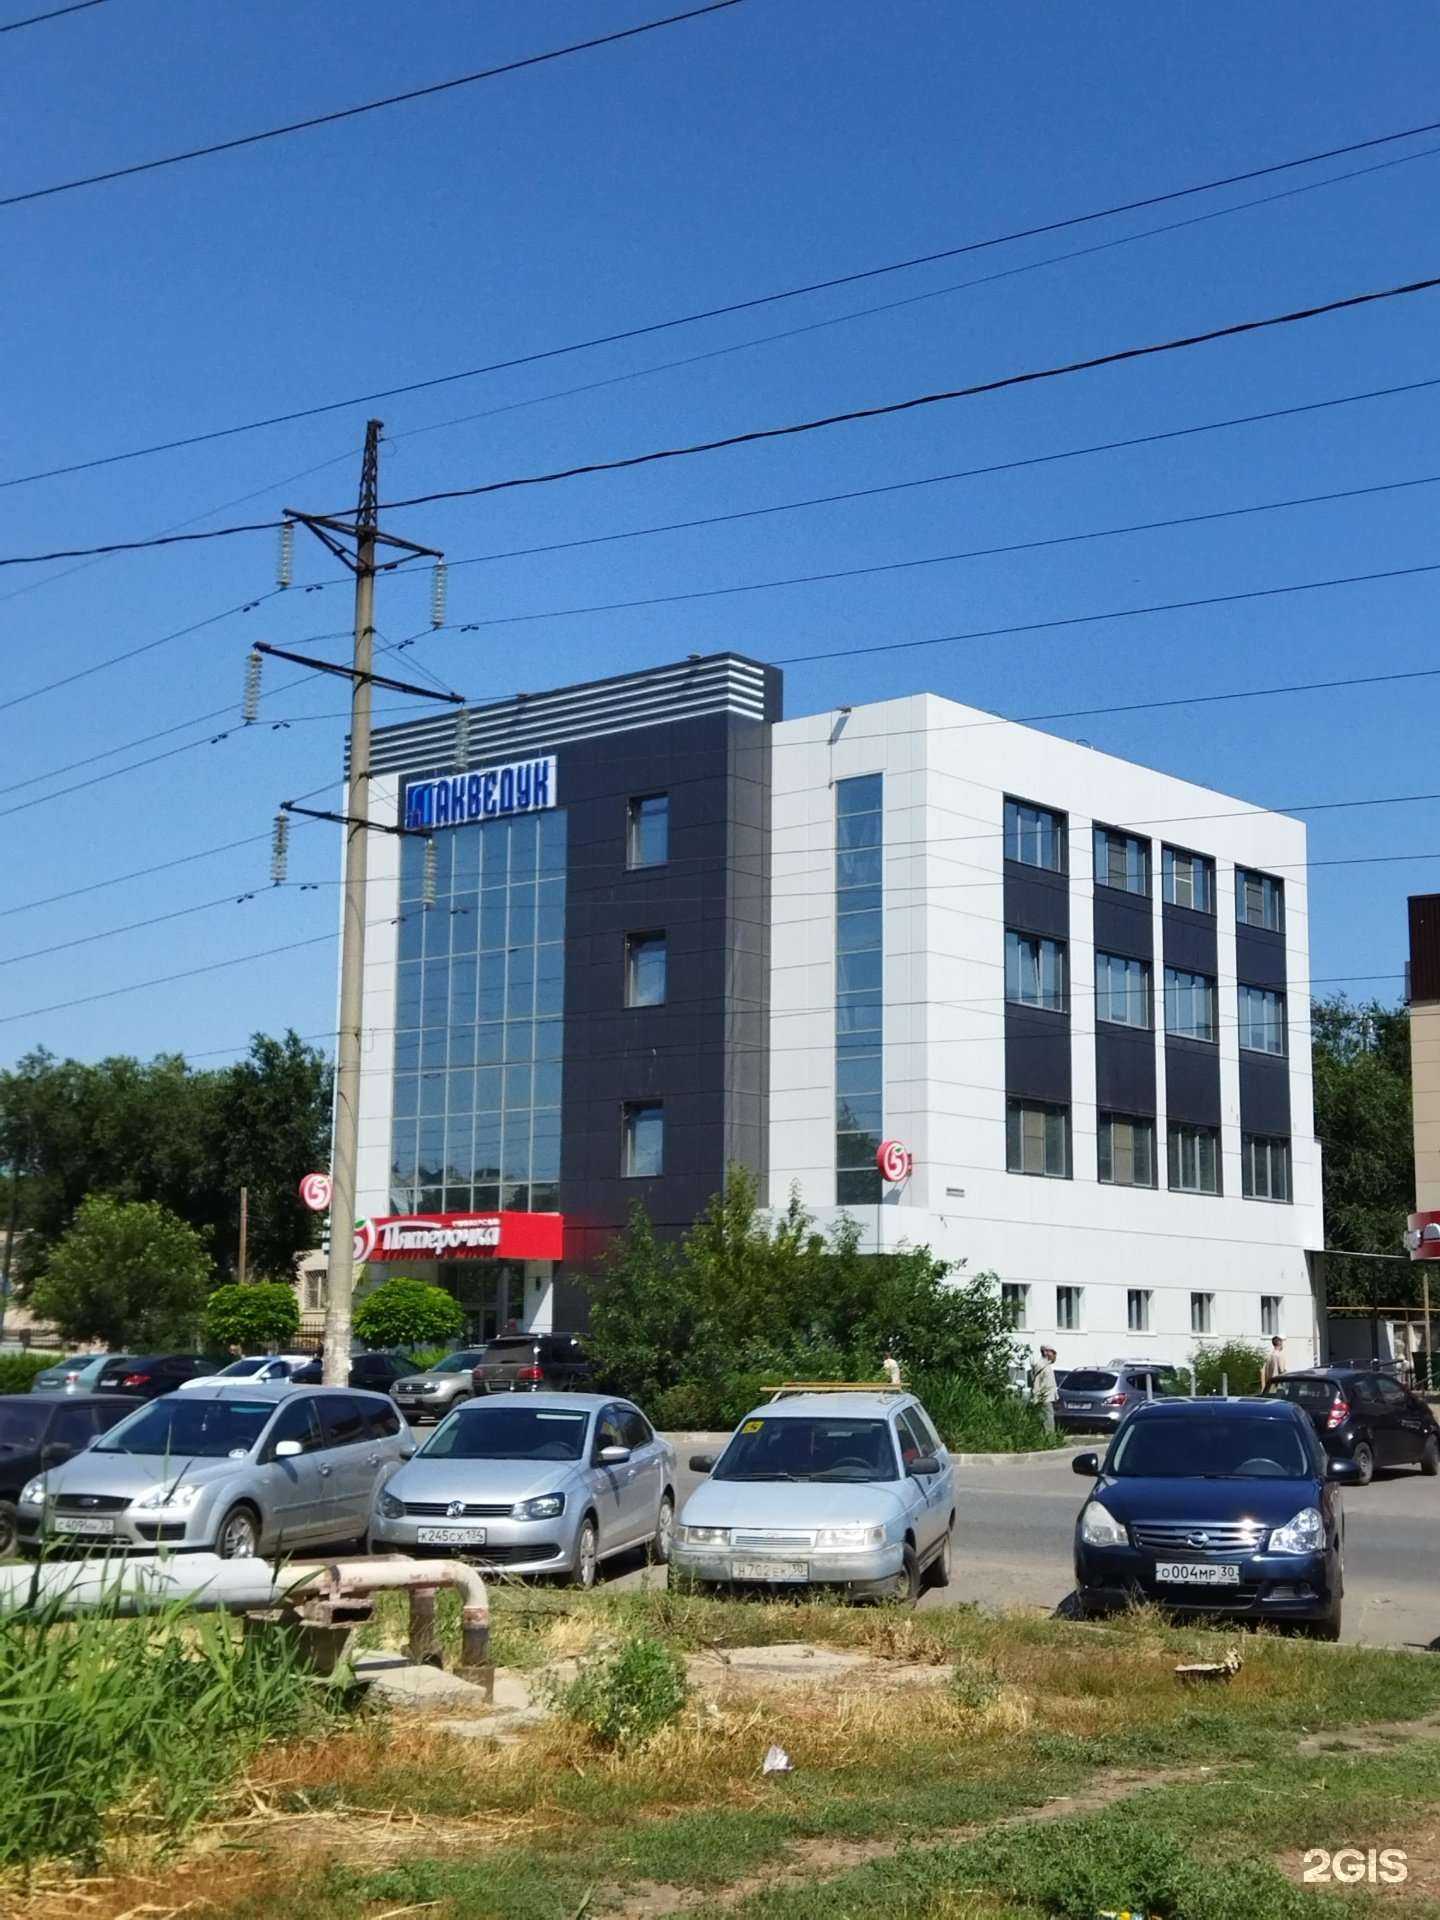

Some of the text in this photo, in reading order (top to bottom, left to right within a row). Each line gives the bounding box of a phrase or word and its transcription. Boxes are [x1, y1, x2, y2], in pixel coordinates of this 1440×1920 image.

[435, 759, 549, 824] АКВЕДУК
[377, 1220, 500, 1255] Пятерочка
[1161, 1565, 1235, 1580] О004МР 30
